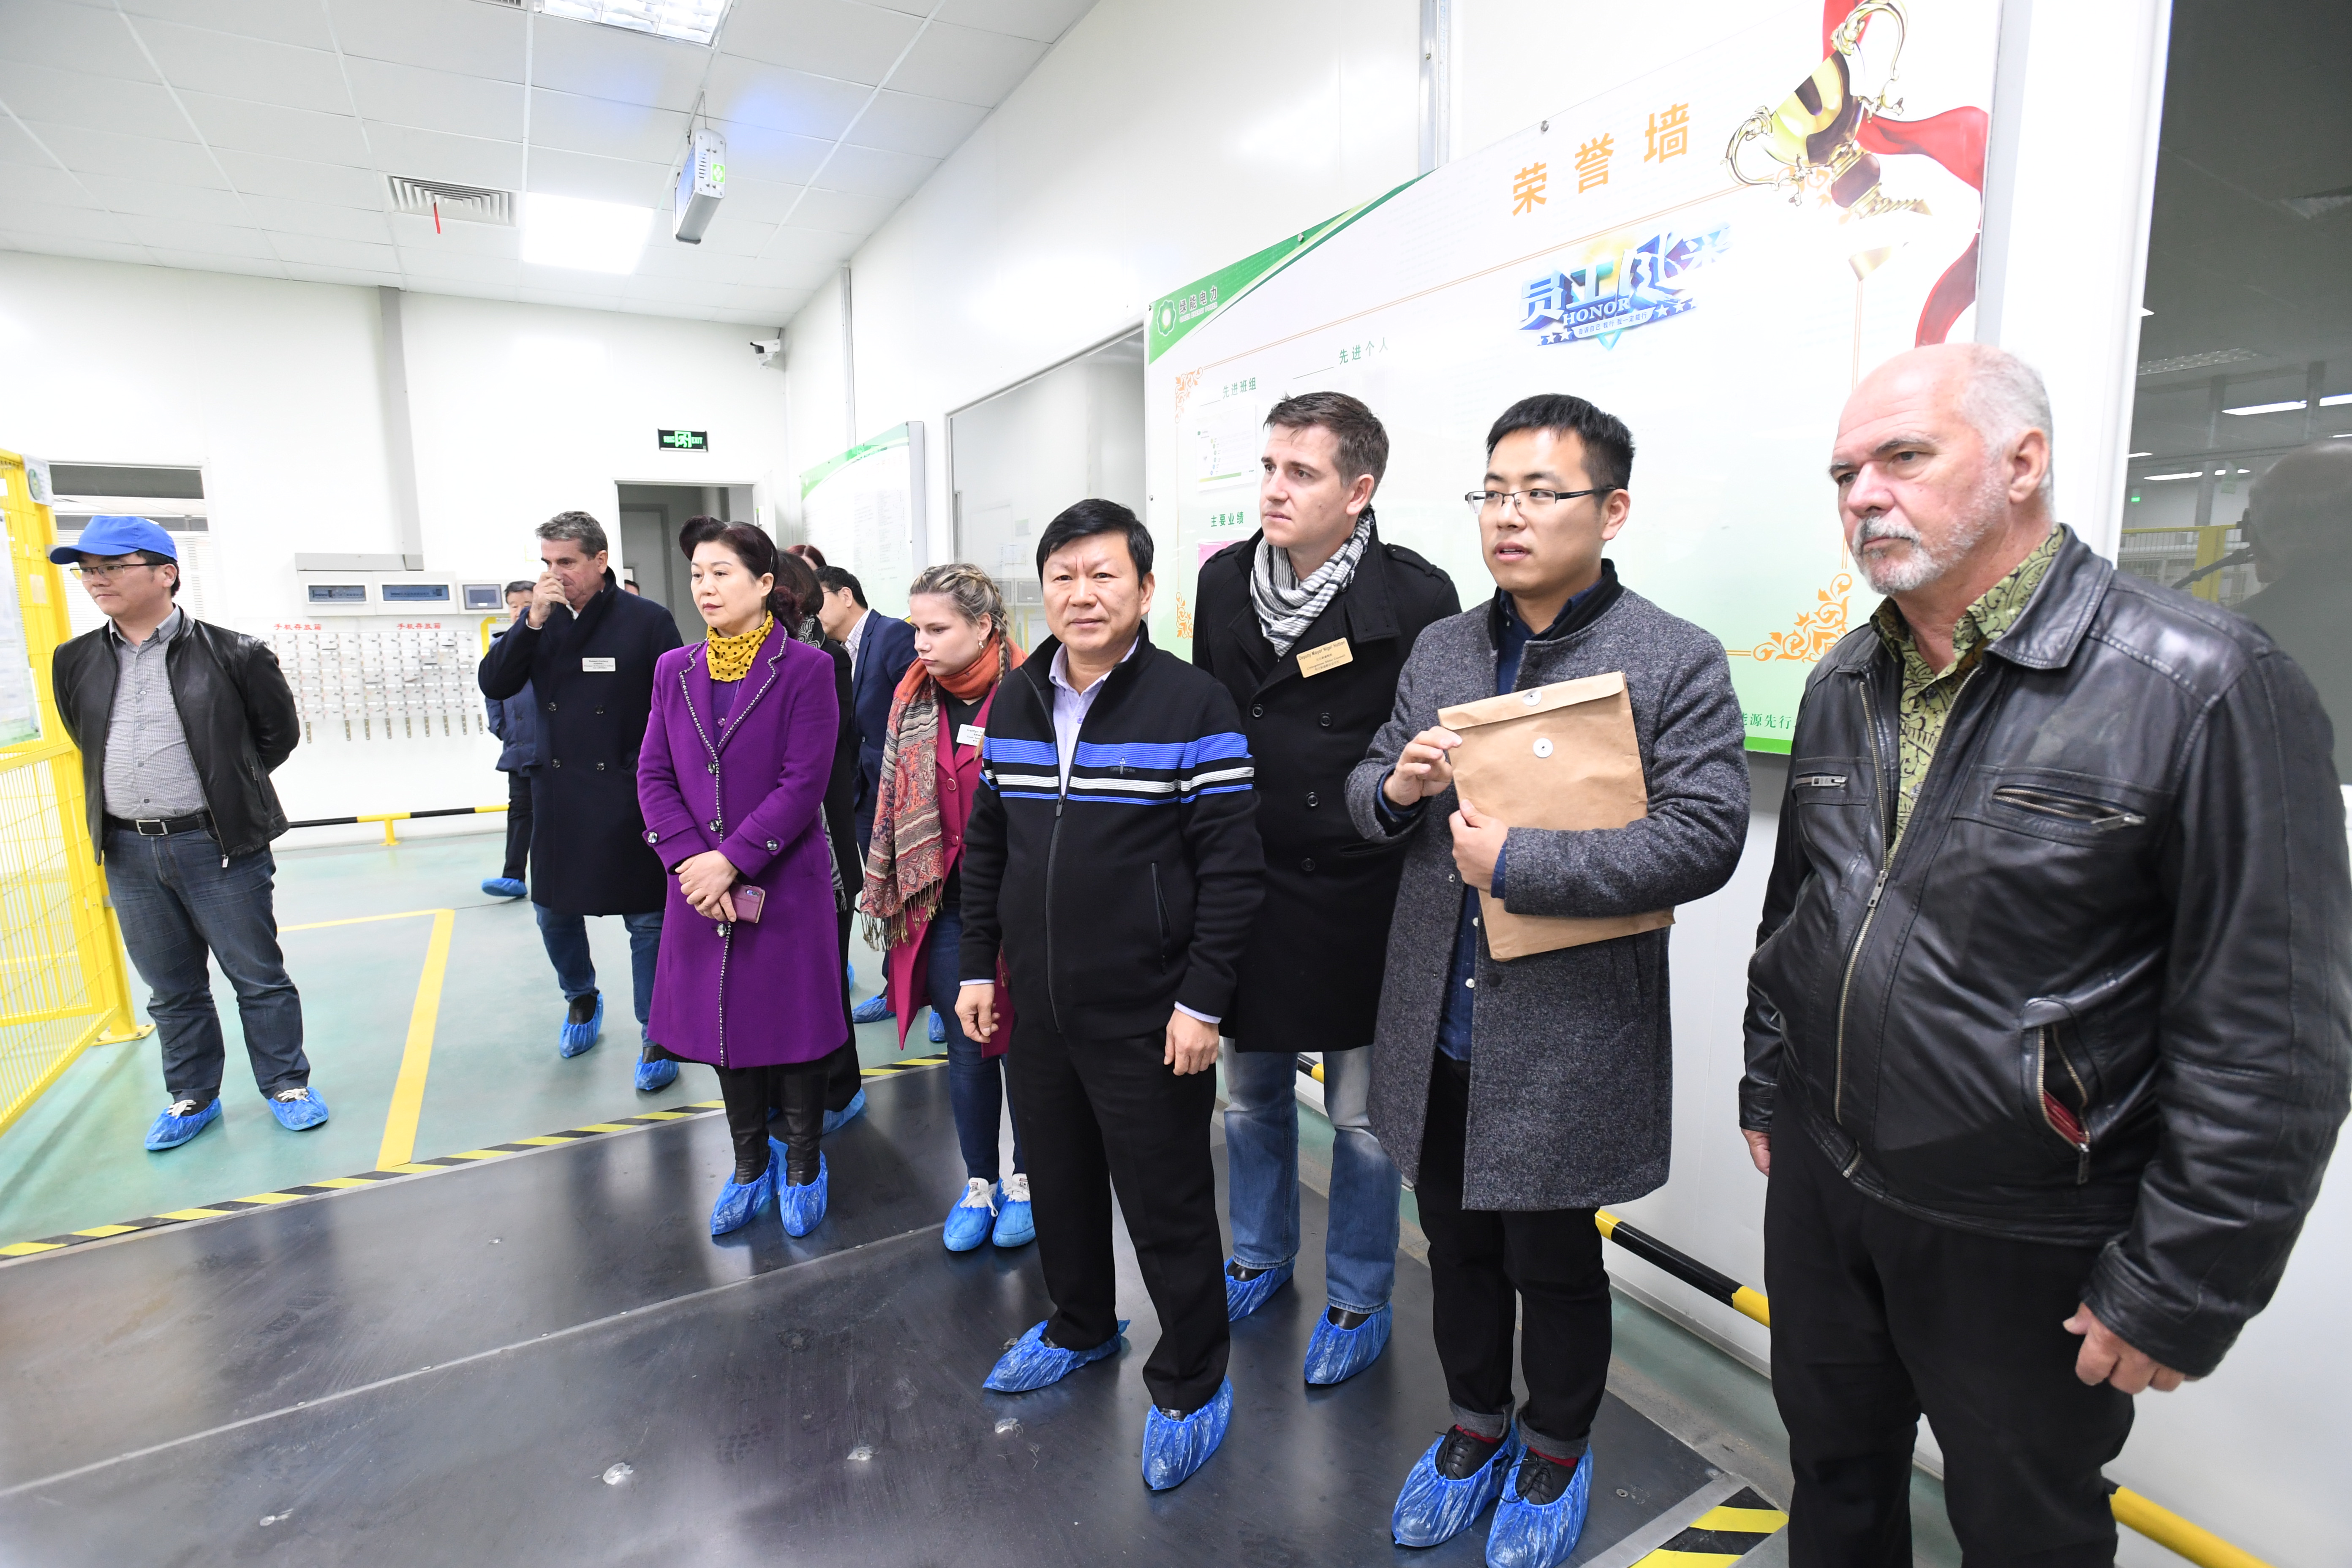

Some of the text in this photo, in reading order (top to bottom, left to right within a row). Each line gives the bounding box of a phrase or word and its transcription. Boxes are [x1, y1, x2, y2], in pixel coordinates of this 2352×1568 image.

[1512, 103, 1689, 216] 荣誉墙
[1520, 223, 1730, 329] 员工风采
[1180, 286, 1217, 313] 绿能电力
[1563, 297, 1631, 327] HONOR
[1579, 324, 1600, 335] 告诉自己
[1339, 337, 1388, 365] 先进个人
[1223, 377, 1256, 399] 先进班组
[1211, 511, 1244, 527] 主要业绩
